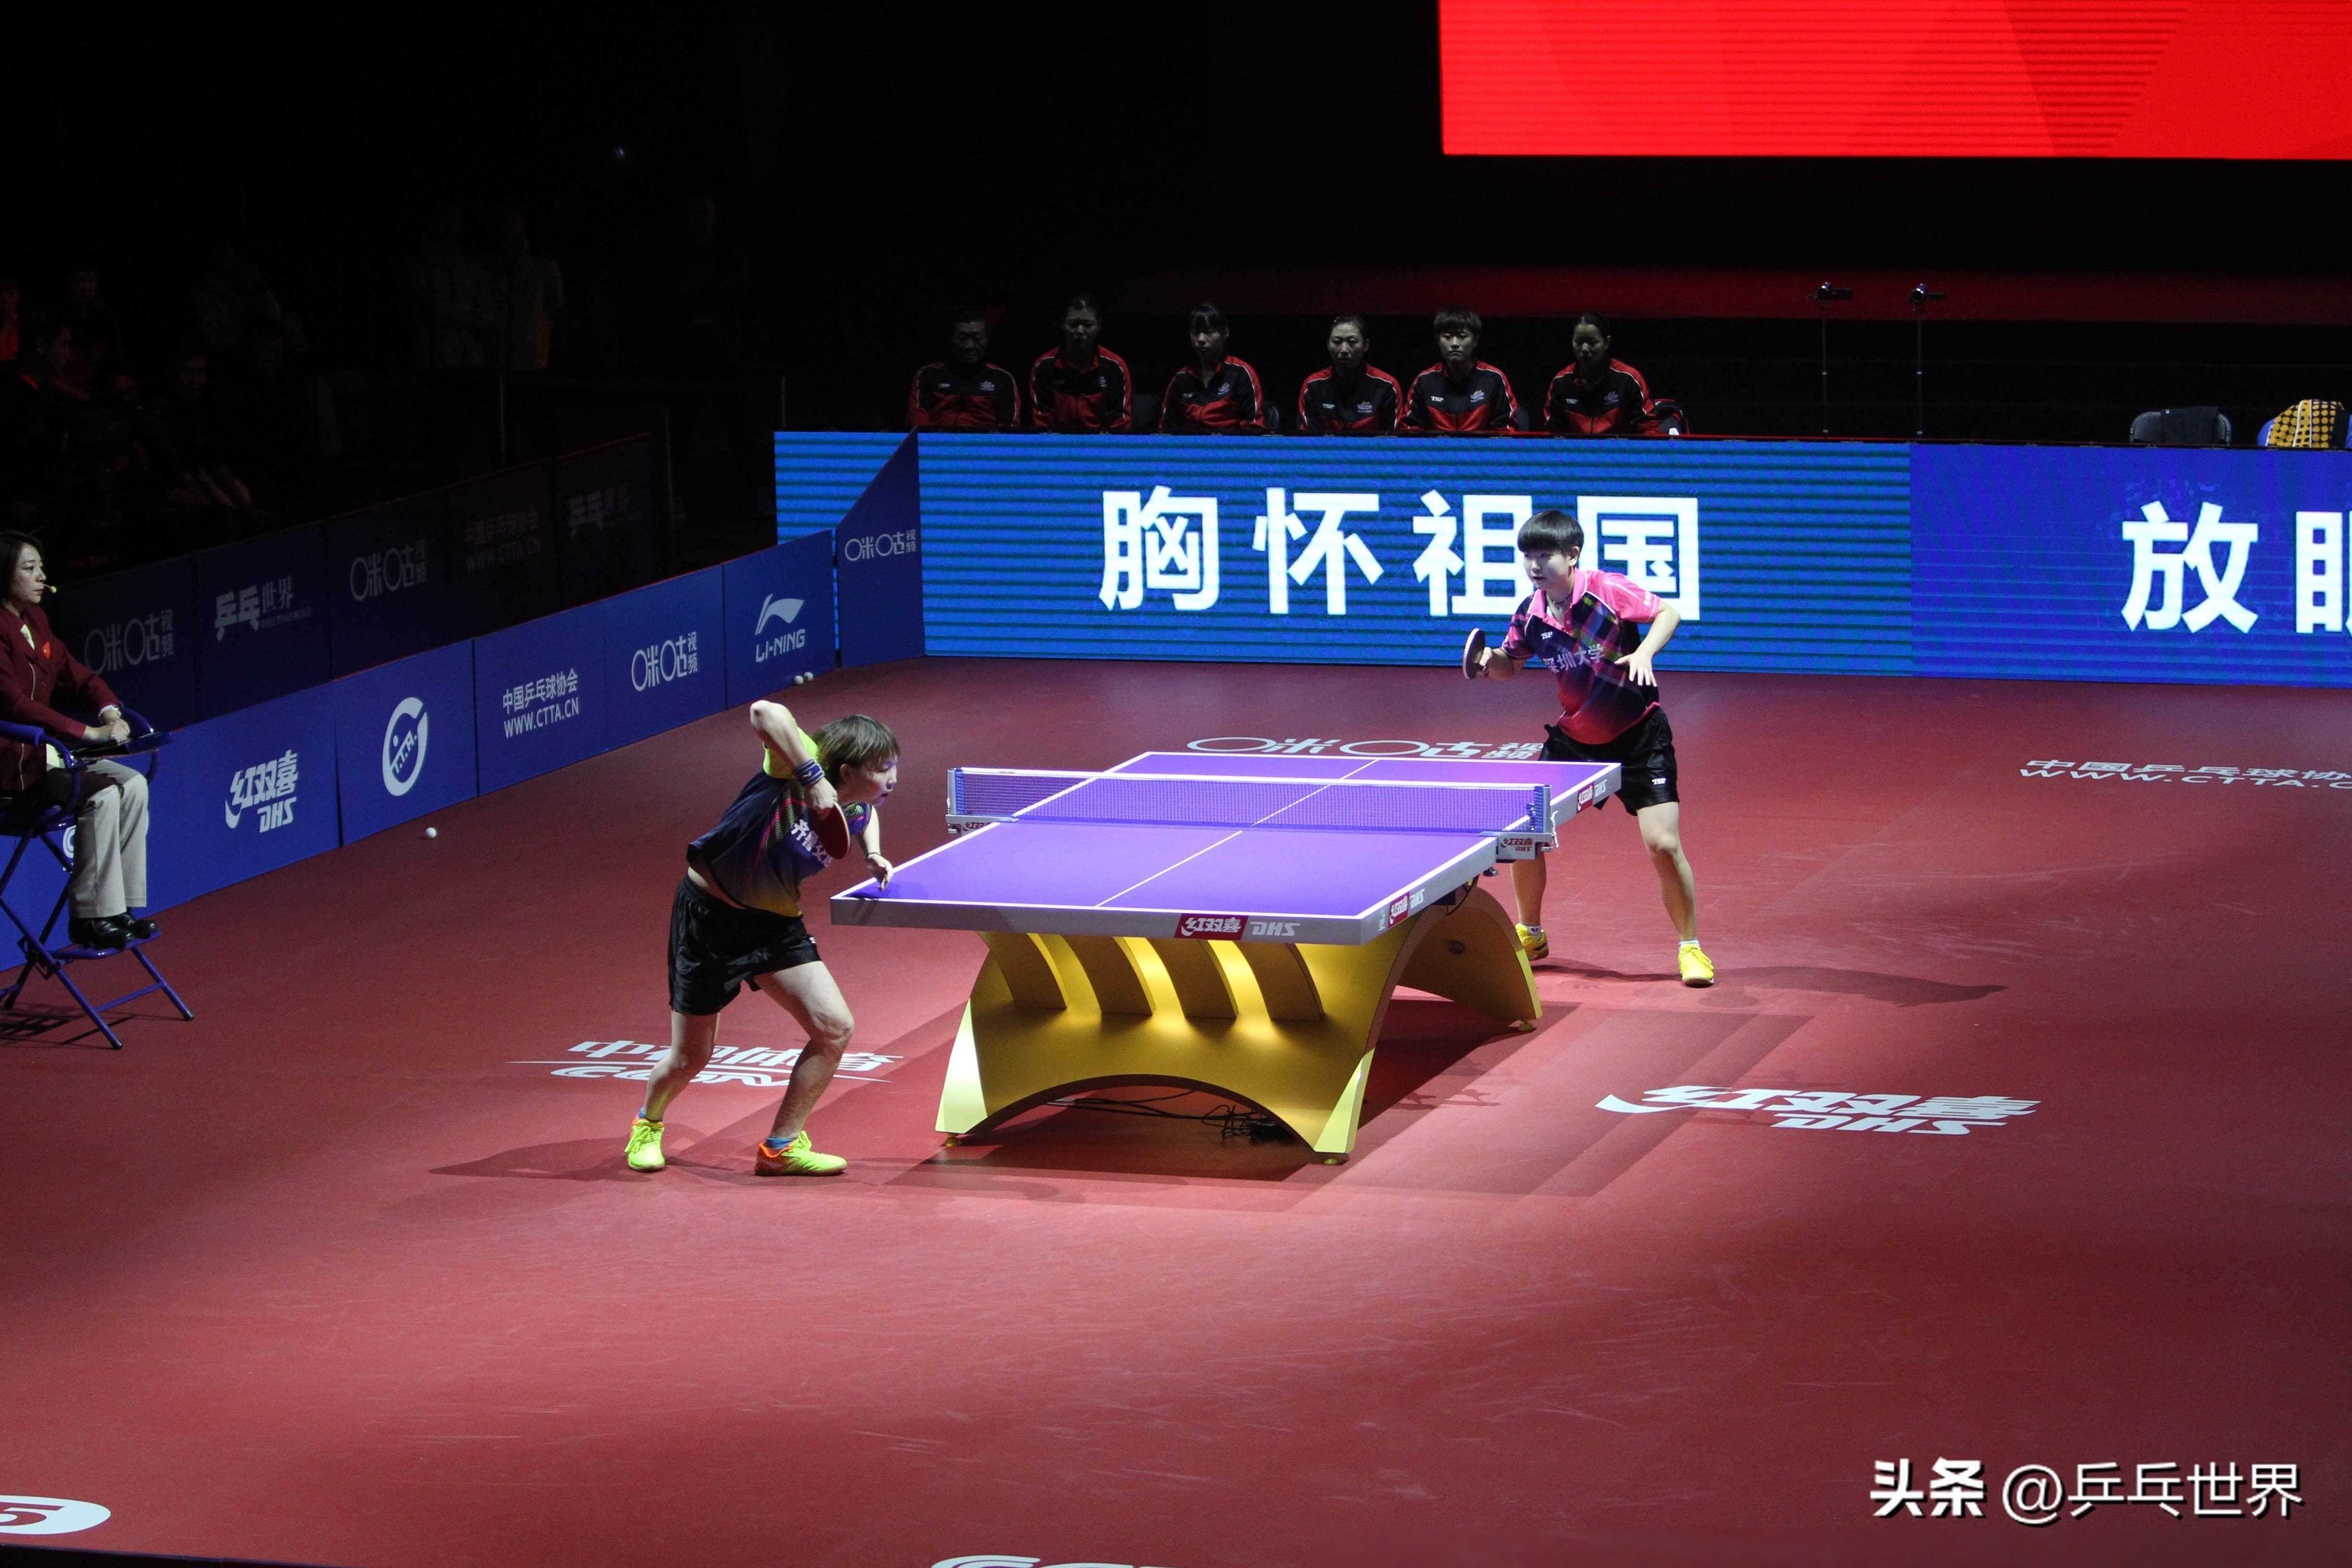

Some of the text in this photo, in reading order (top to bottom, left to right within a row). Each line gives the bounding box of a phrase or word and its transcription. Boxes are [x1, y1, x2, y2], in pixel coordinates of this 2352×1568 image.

[1099, 486, 1700, 621] 胸怀祖国
[755, 629, 806, 662] LI-NING
[1541, 631, 1553, 639] TSP
[502, 668, 578, 714] 中国乒乓球协会
[503, 697, 579, 738] WWW.CTTA.CN
[225, 749, 298, 829] 红双喜
[257, 796, 297, 833] DHS
[1181, 917, 1241, 937] 红双喜
[1249, 921, 1300, 936] DHS
[1595, 1086, 2042, 1119] 红双喜
[1769, 1113, 2008, 1135] DHS
